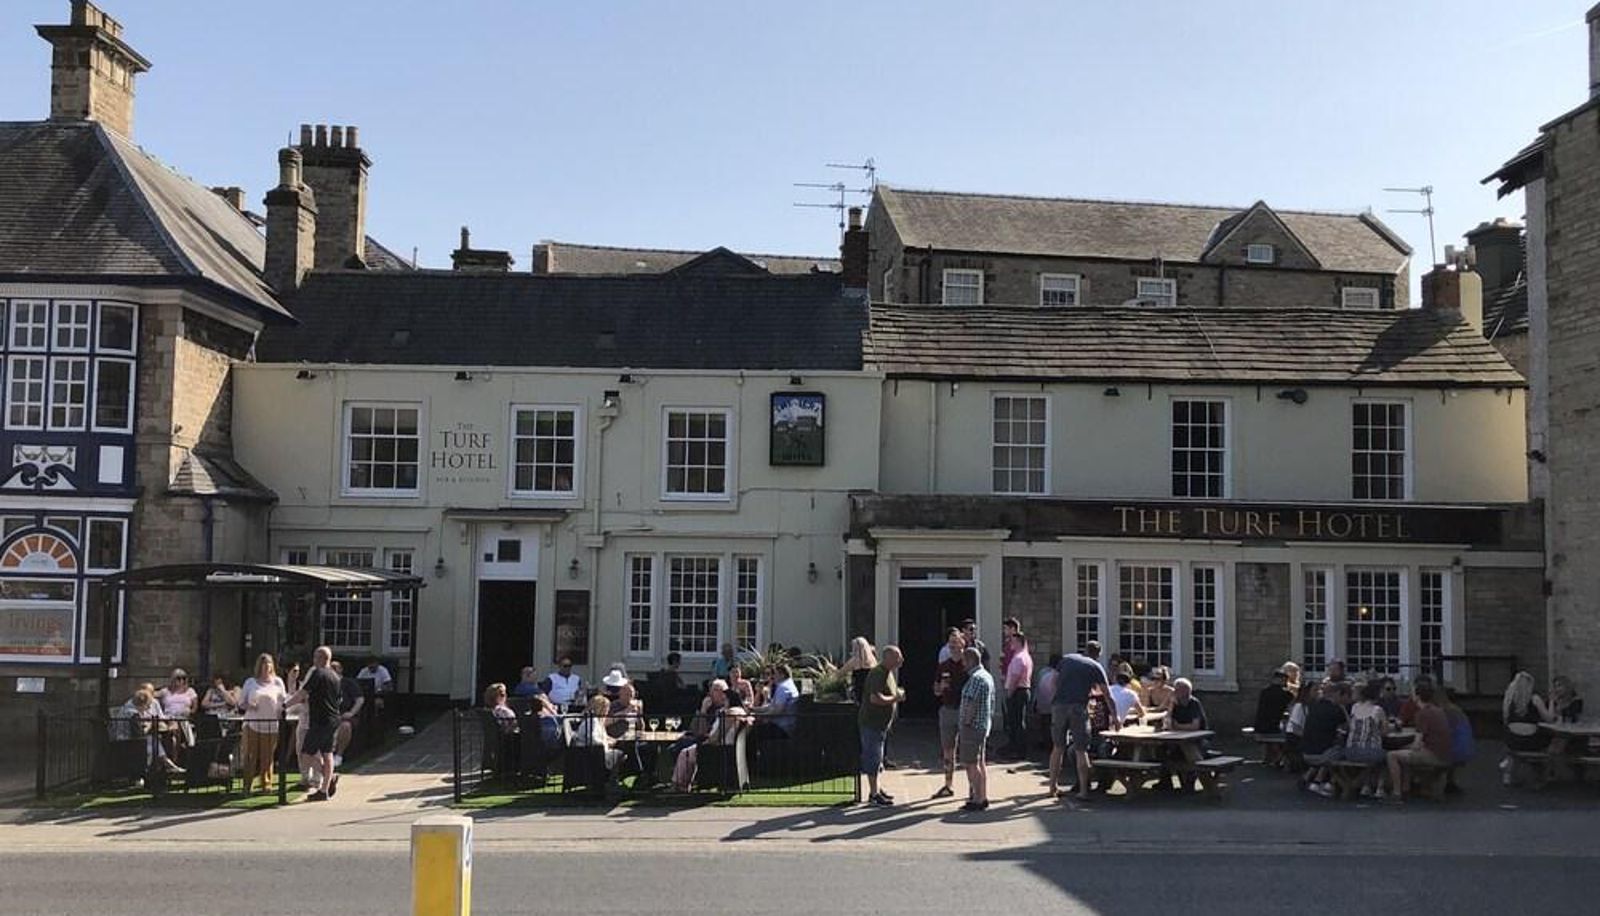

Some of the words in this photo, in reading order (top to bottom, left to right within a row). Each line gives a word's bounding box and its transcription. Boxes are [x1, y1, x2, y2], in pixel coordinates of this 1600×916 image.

[439, 430, 491, 448] TURF
[432, 451, 497, 469] HOTEL
[1113, 506, 1182, 534] THE
[1194, 507, 1281, 537] TURF
[1299, 510, 1409, 538] HOTEL
